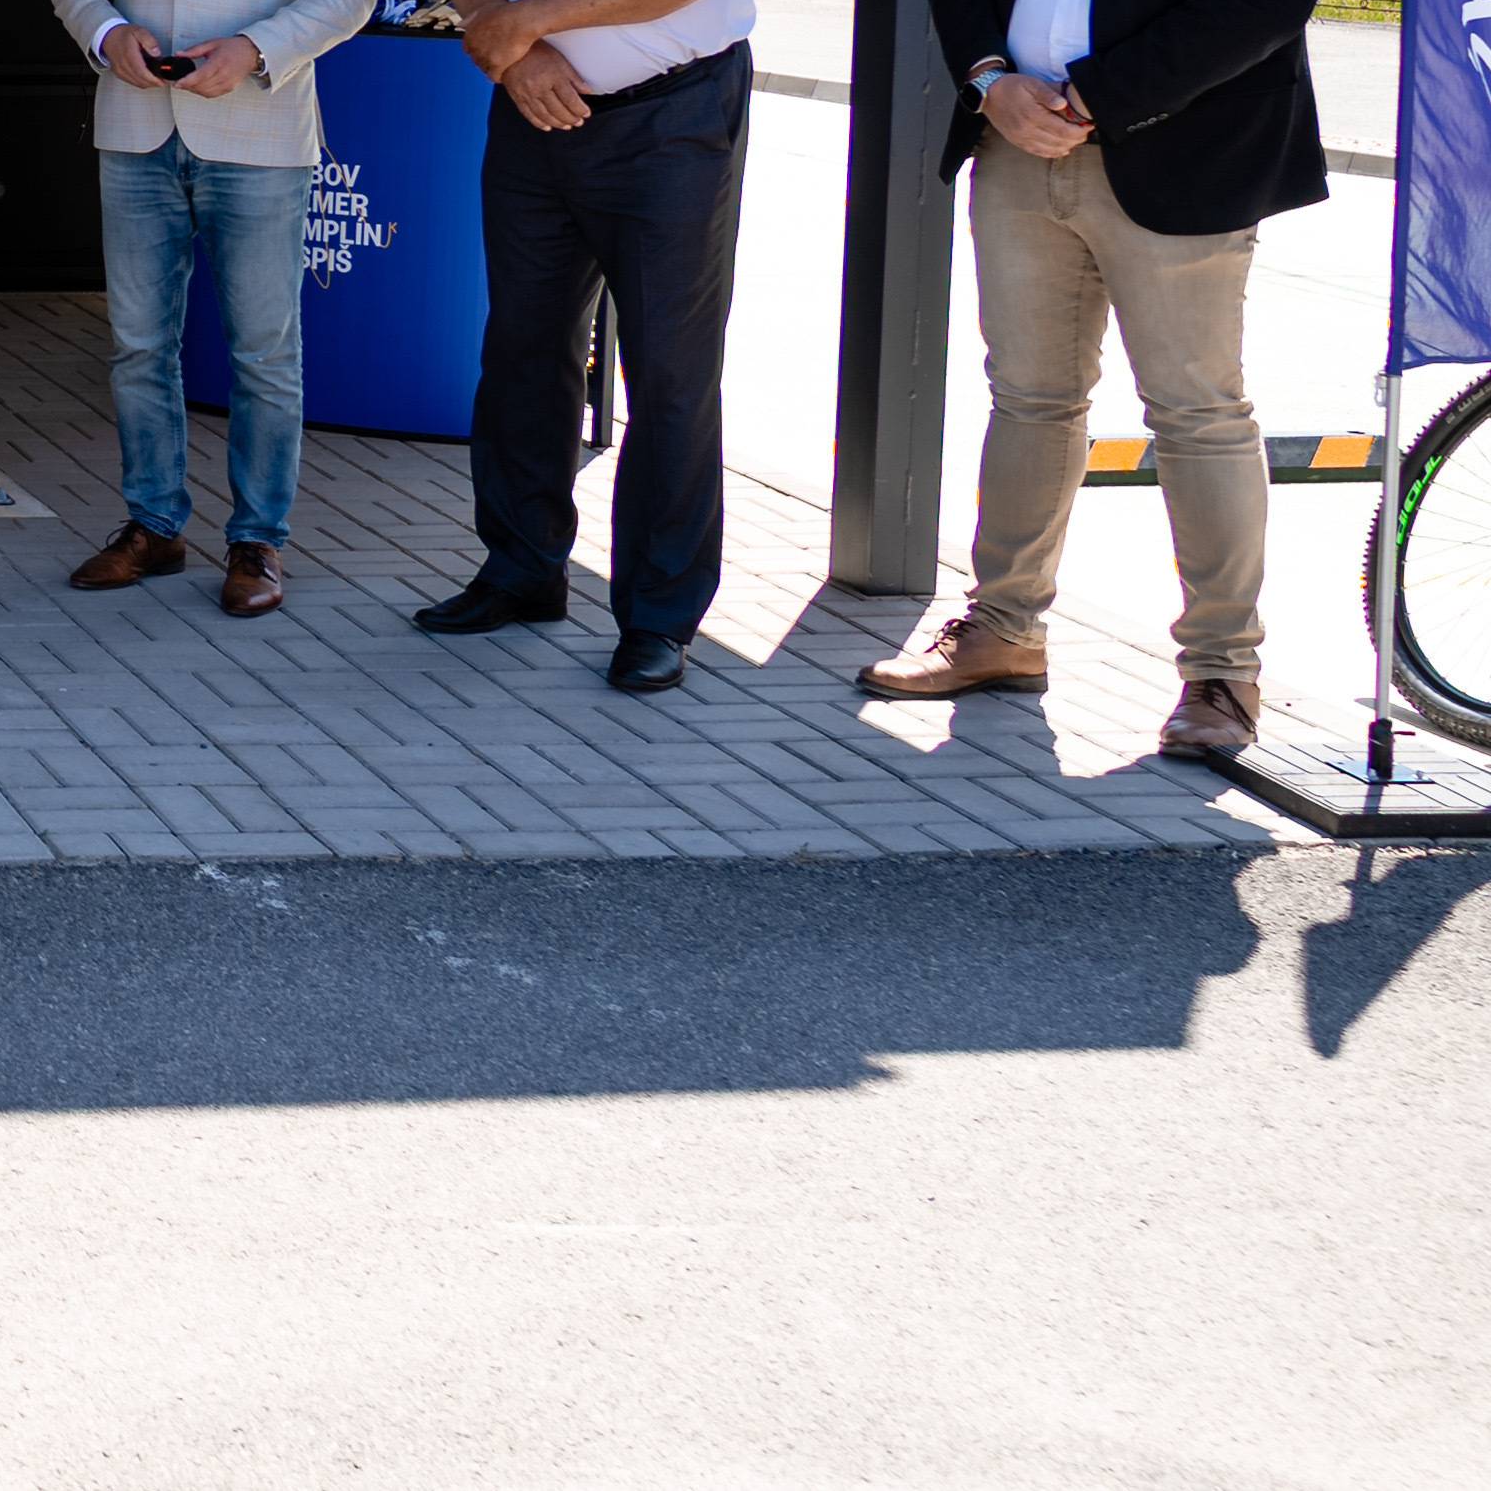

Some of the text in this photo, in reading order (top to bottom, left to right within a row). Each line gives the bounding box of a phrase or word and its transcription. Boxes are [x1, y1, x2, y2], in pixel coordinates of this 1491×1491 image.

[312, 162, 361, 188] BOV
[311, 190, 369, 217] MER
[303, 216, 382, 247] MPLÍN
